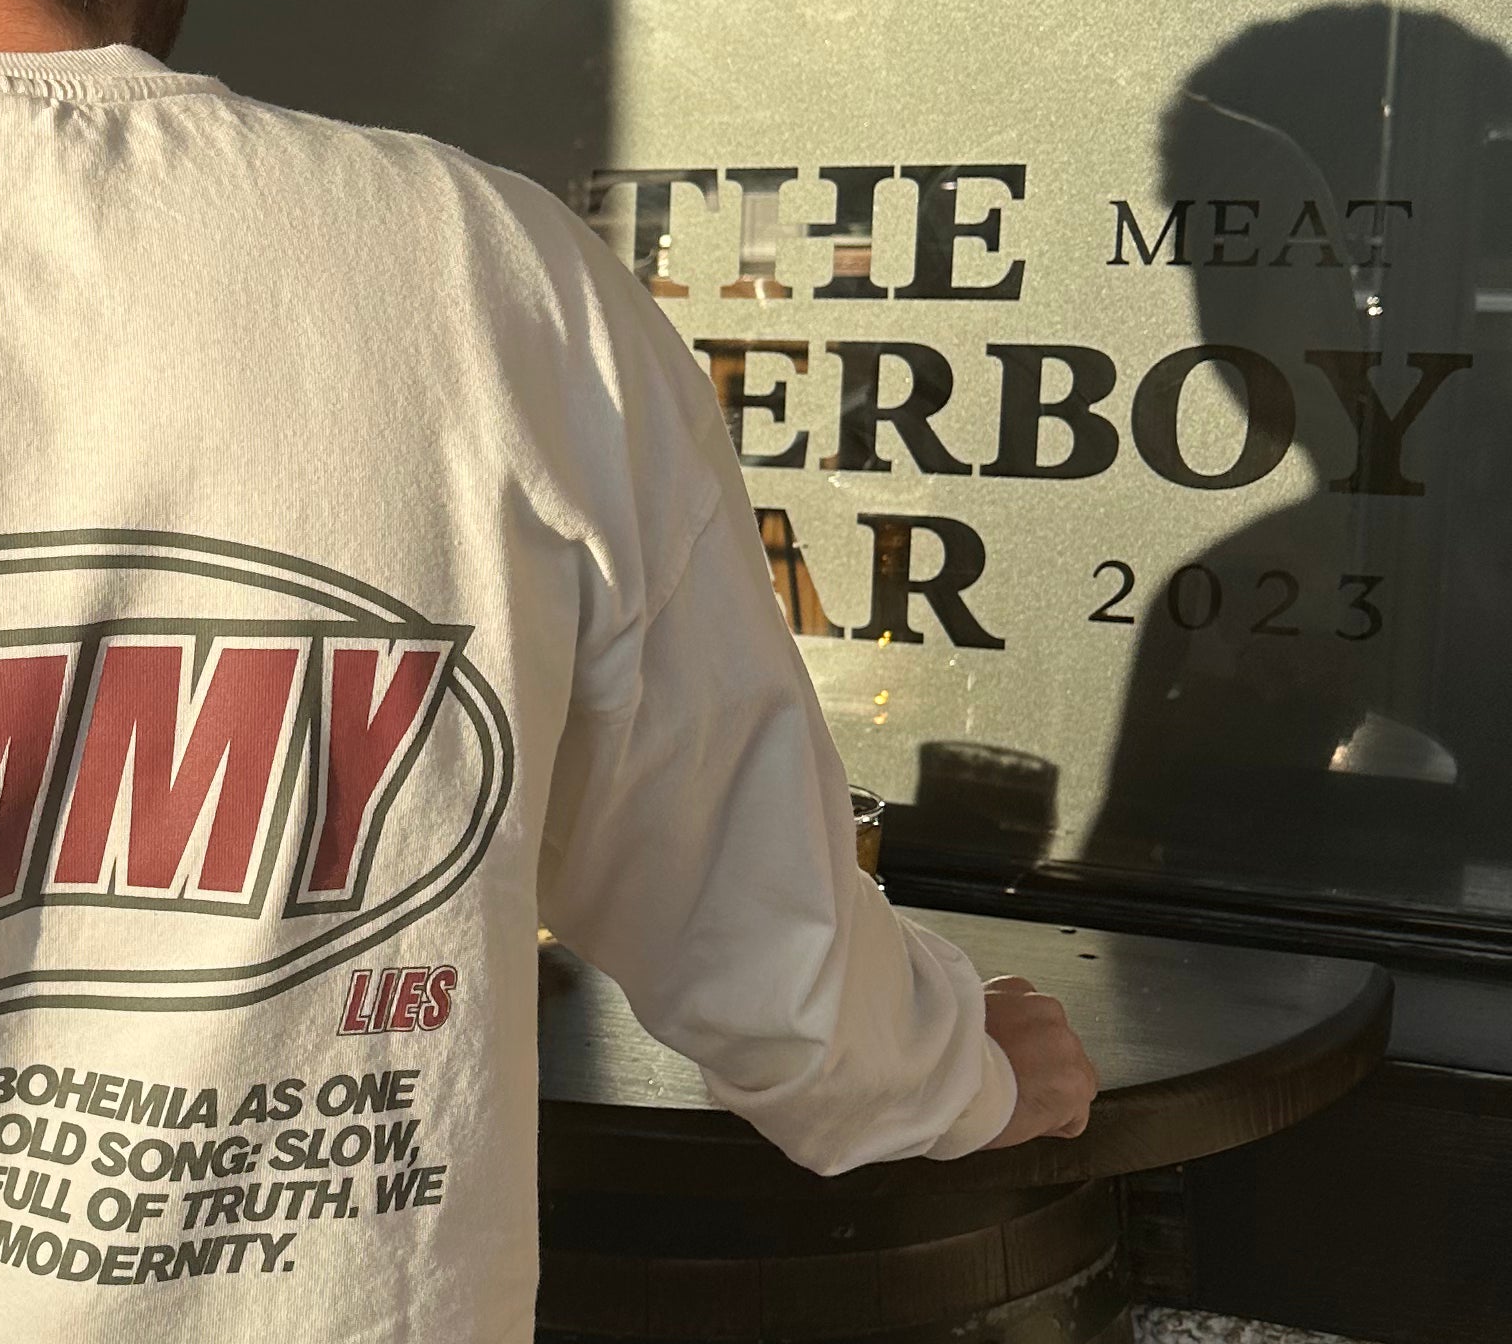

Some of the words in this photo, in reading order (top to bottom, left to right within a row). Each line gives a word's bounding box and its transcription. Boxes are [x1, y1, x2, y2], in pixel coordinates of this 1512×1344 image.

[589, 164, 1028, 301] THE
[1105, 199, 1414, 269] MEAT
[1088, 560, 1385, 641] 2023
[337, 964, 458, 1036] LIES
[230, 1078, 307, 1127] AS
[315, 1069, 421, 1118] ONE
[90, 1131, 262, 1183] SONG:
[268, 1119, 421, 1171] SLOW,
[86, 1186, 170, 1234] OF
[181, 1177, 359, 1231] TRUTH.
[374, 1164, 448, 1215] WE
